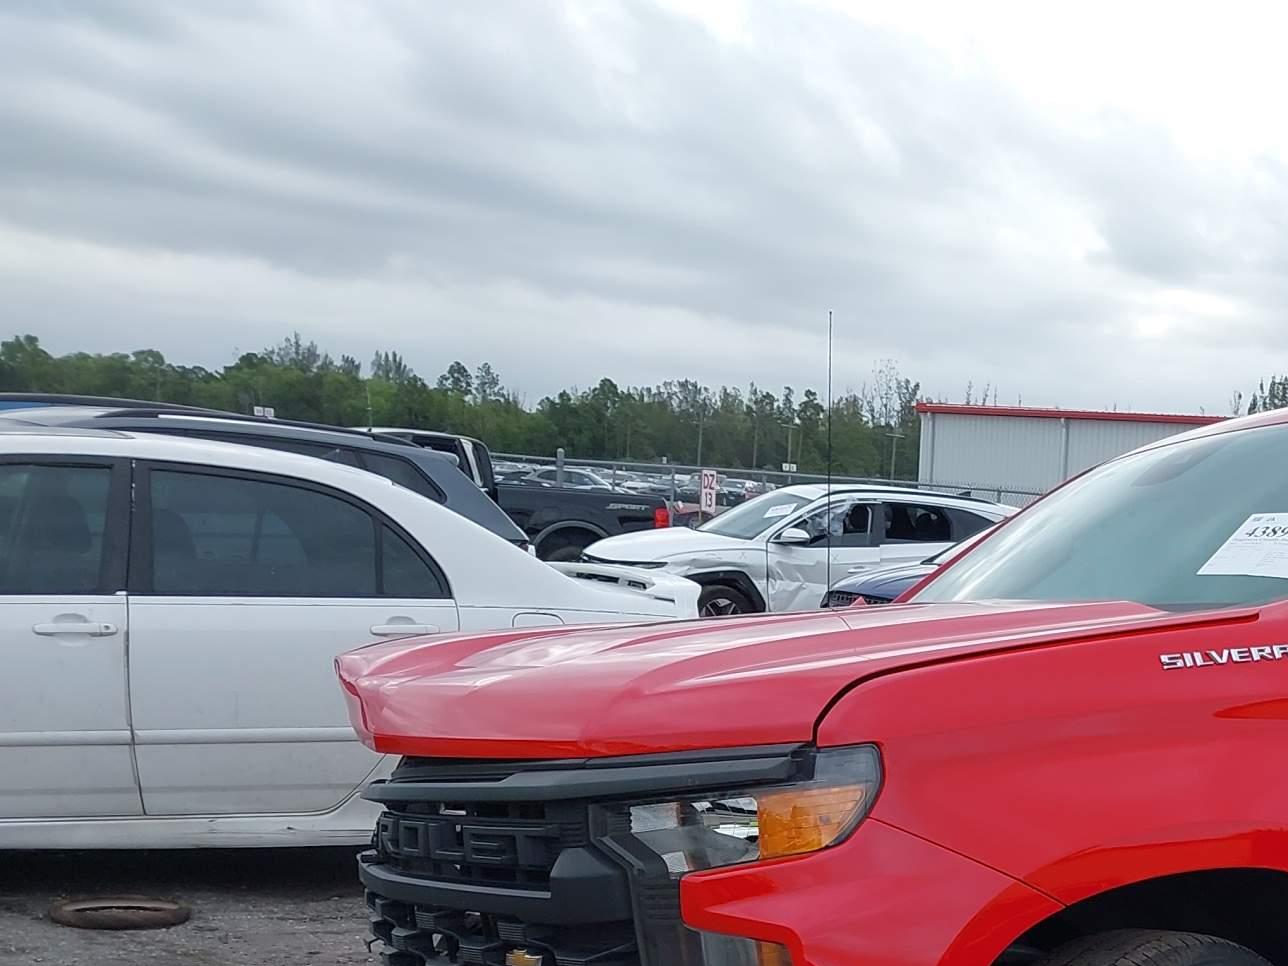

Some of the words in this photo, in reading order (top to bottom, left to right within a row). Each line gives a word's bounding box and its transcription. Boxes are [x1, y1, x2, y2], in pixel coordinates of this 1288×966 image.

[703, 473, 715, 490] DZ
[606, 503, 650, 511] SPORT
[705, 492, 713, 508] 13
